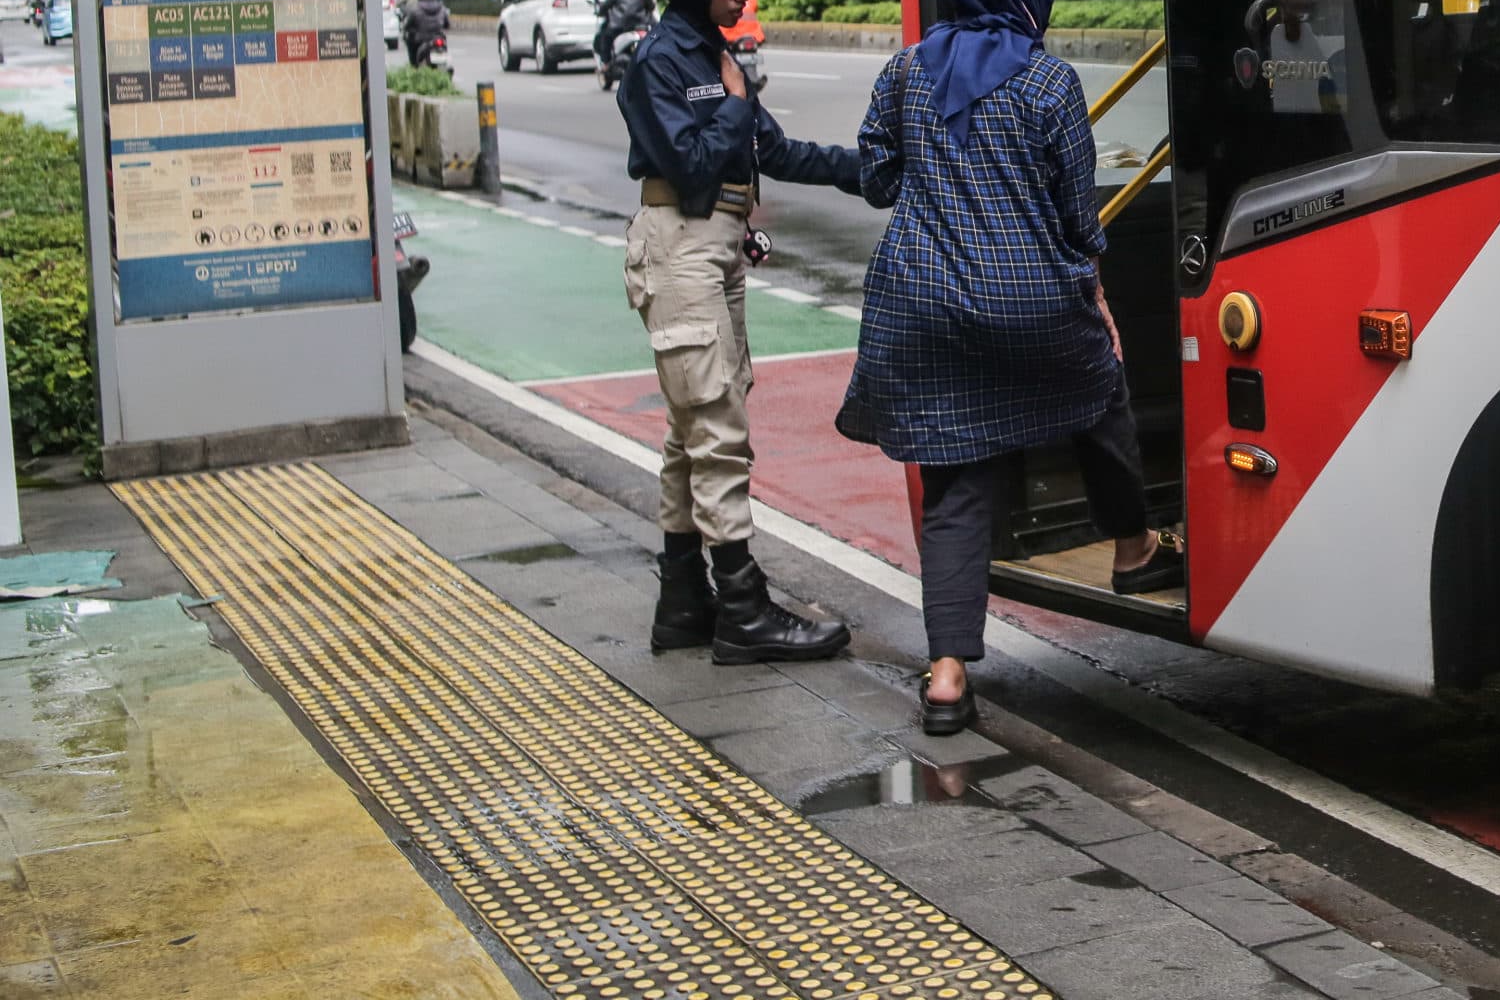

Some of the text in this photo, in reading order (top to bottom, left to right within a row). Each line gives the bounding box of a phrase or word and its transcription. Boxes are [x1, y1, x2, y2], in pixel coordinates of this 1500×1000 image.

[155, 7, 184, 23] AC05
[194, 5, 231, 21] AC121
[239, 4, 269, 19] AC34
[1262, 59, 1331, 81] SCANIA
